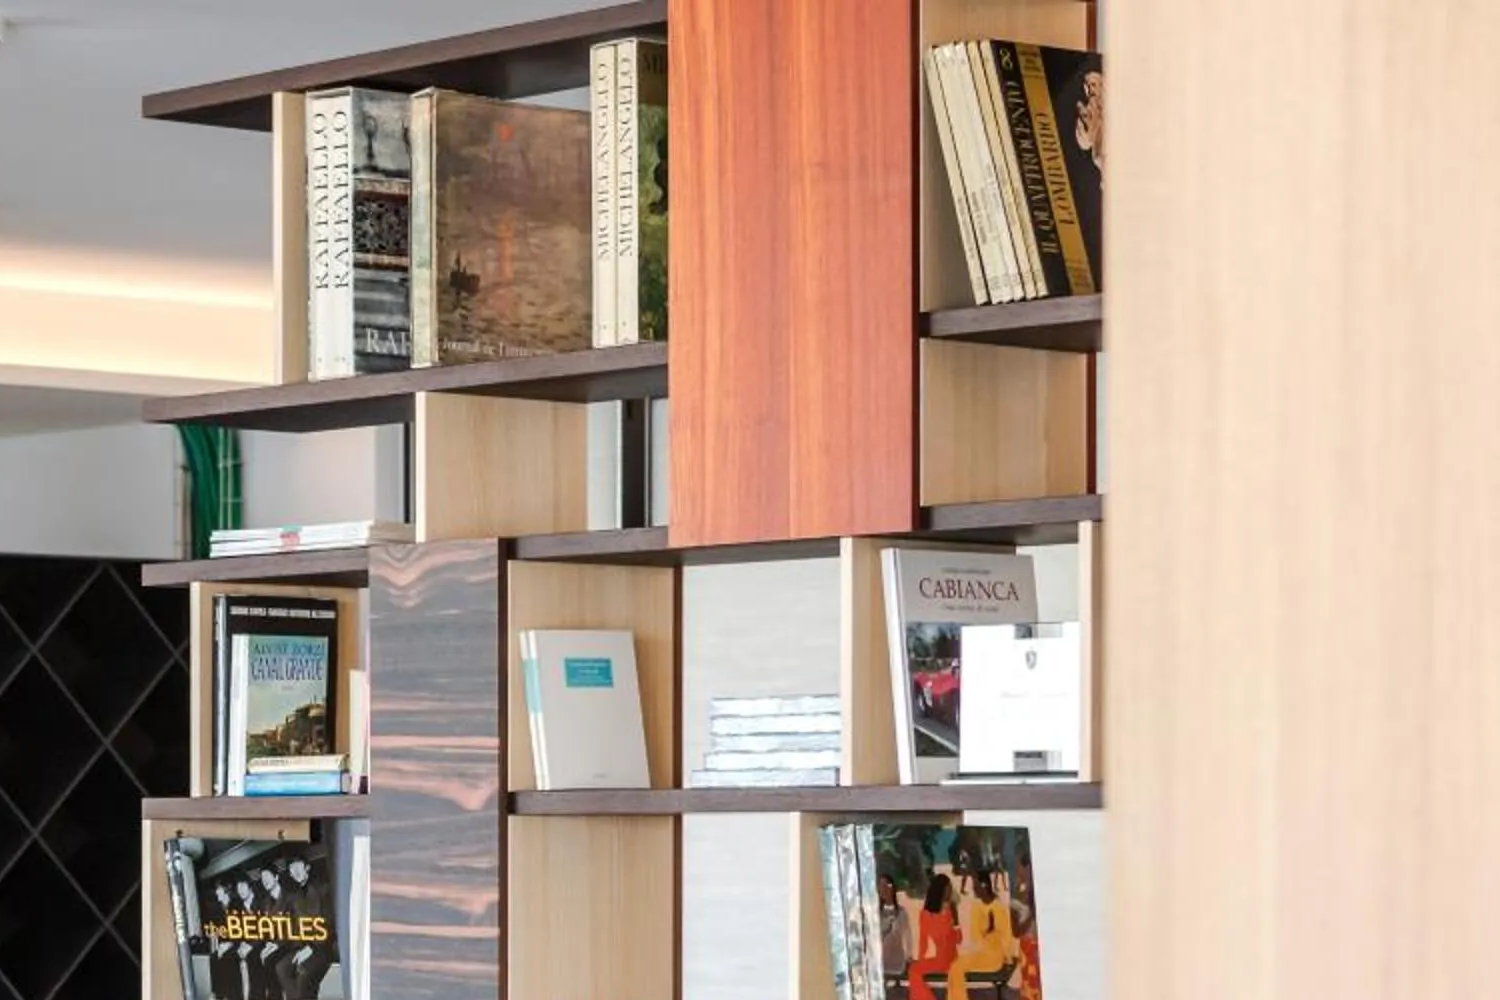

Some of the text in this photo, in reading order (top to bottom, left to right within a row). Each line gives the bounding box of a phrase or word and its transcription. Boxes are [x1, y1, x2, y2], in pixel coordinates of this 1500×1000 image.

[313, 112, 329, 289] RAFFAELLO
[332, 111, 349, 289] RAFFAELLO
[597, 63, 610, 260] MICHELANGELO
[618, 57, 633, 257] MICHELANGELO
[919, 577, 1019, 601] CABIANCA
[204, 915, 328, 941] the BEATLES
